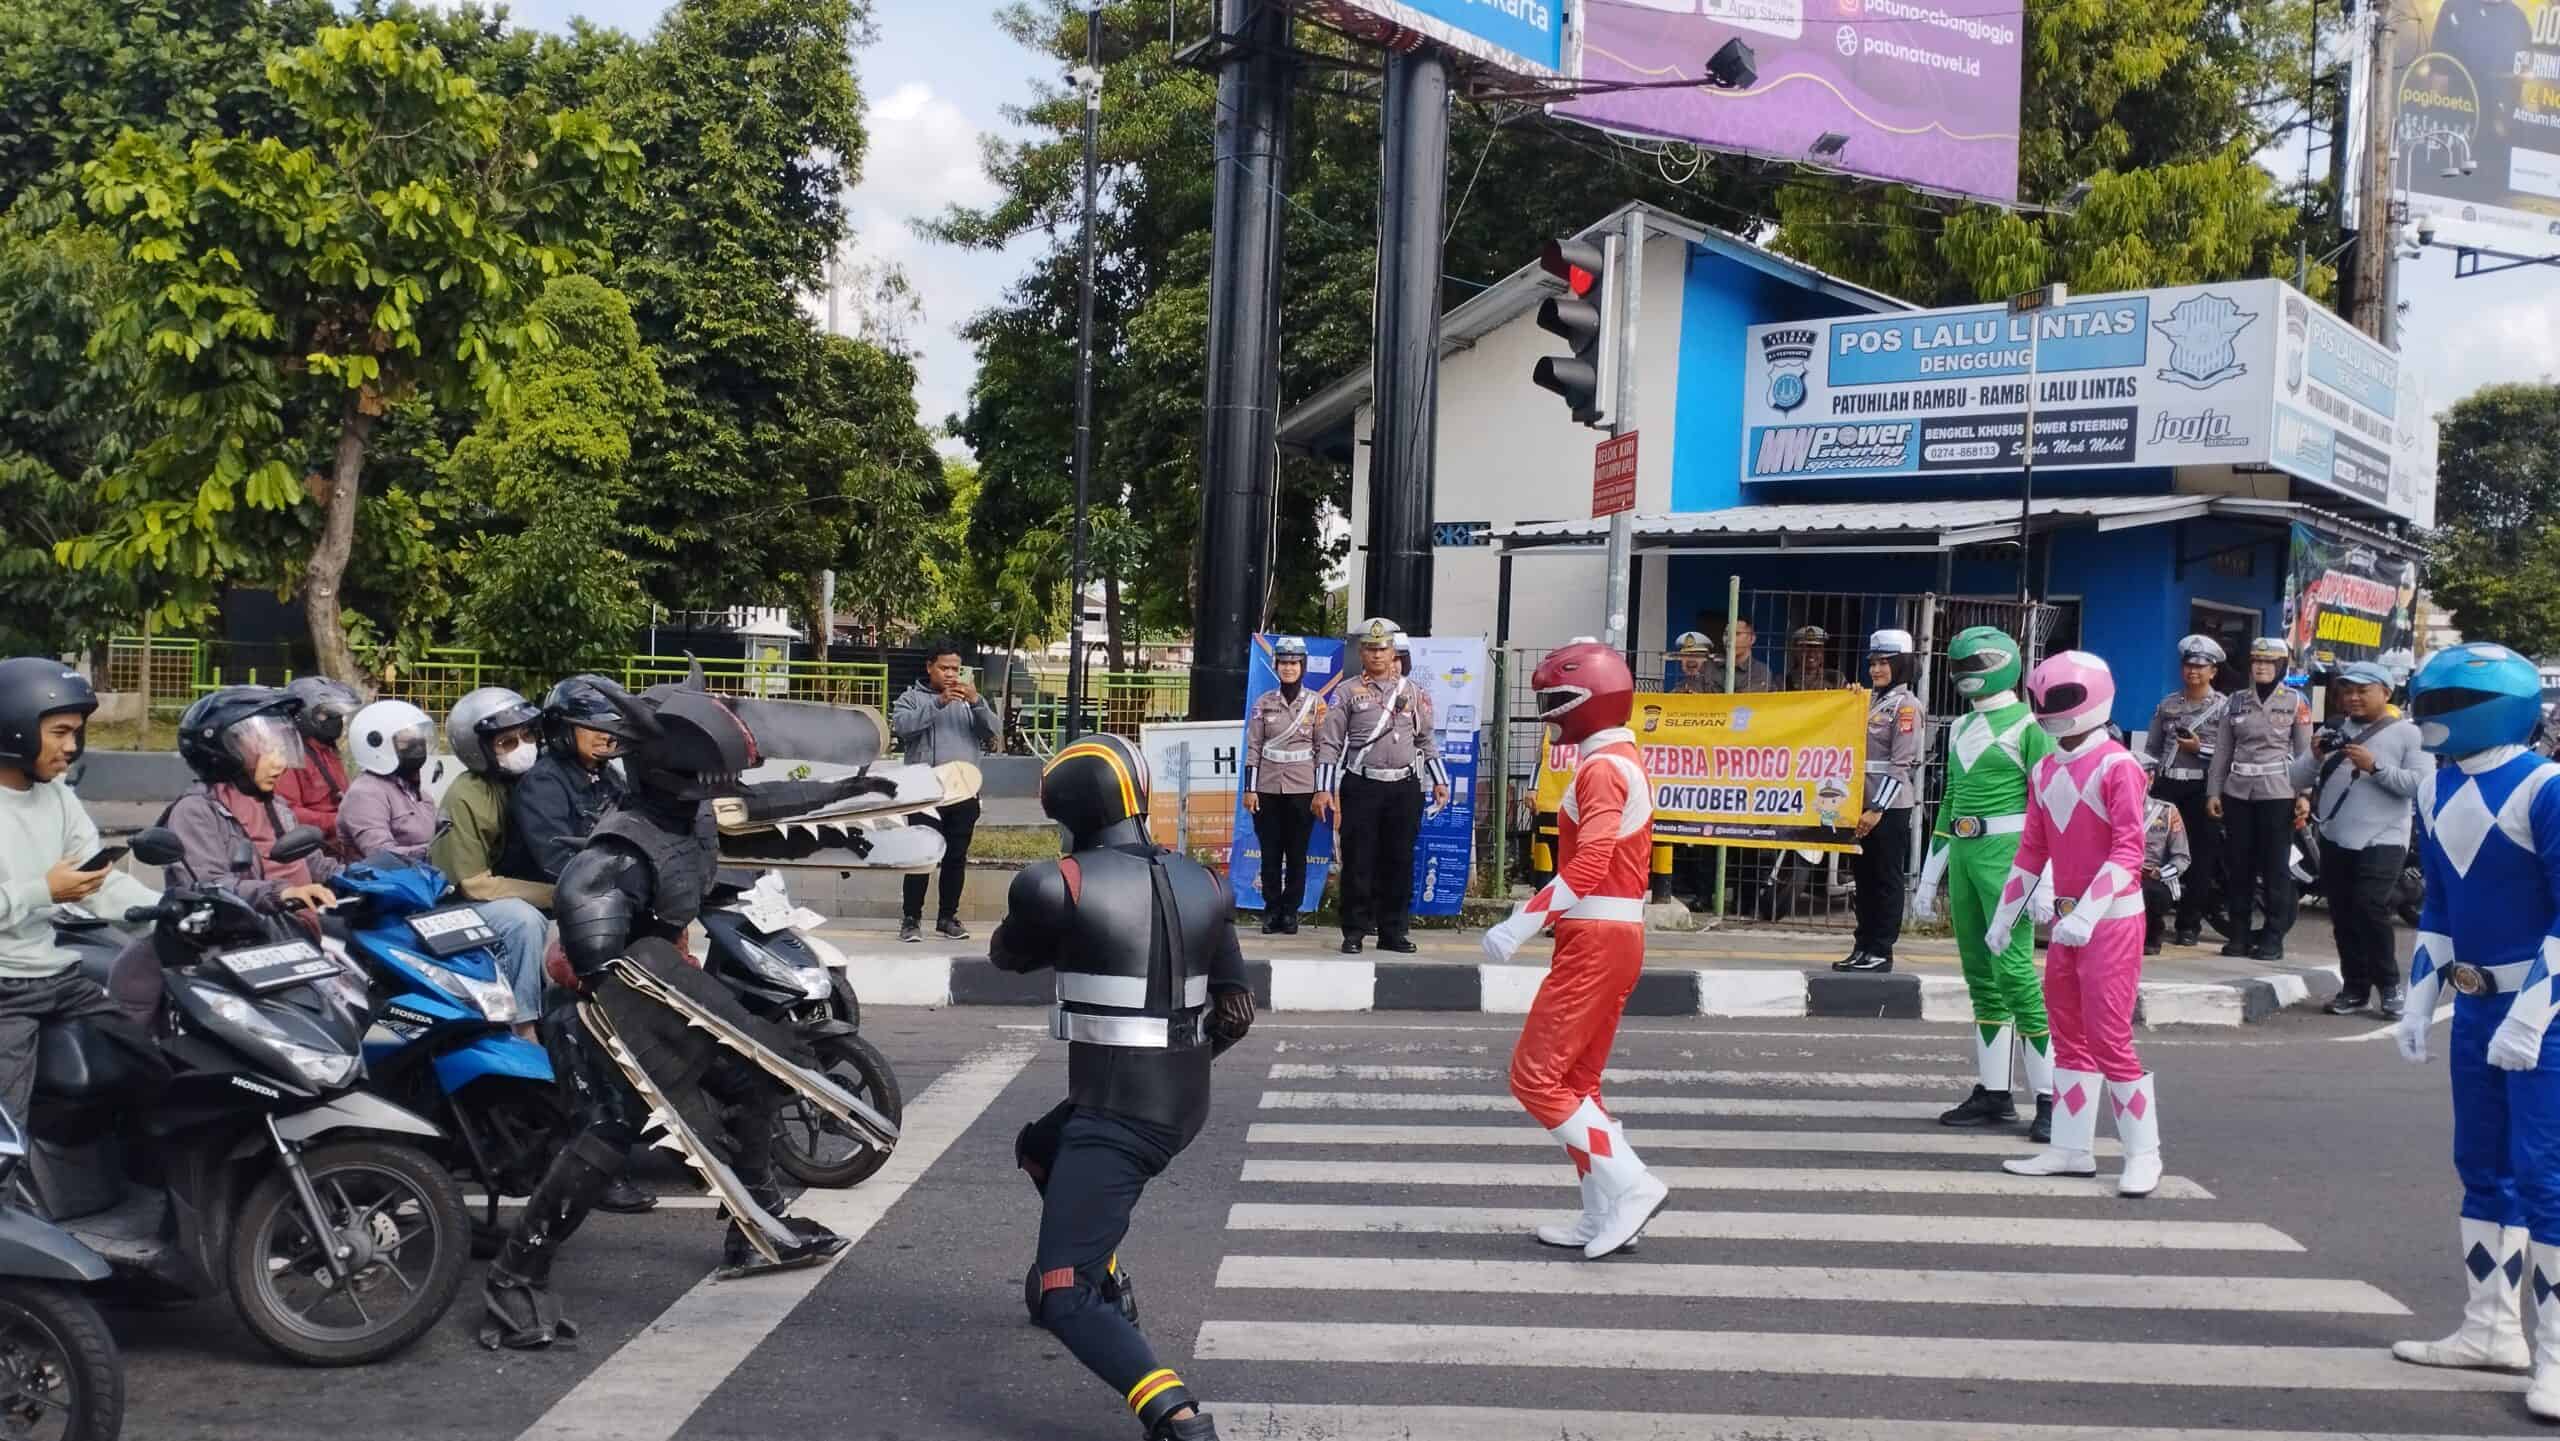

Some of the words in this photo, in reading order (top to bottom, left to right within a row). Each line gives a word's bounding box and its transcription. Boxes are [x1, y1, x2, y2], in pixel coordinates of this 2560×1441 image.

[1863, 37, 1981, 77] patunatravel.id
[1839, 328, 1902, 356] POS
[1912, 320, 1997, 350] LALU
[2009, 309, 2136, 342] LINTAS
[1919, 349, 2033, 374] DENGGUNG
[1832, 391, 1909, 415] PATUHILAH
[1912, 386, 1967, 410] RAMBU
[2040, 380, 2077, 402] LALU
[2081, 376, 2137, 400] LINTAS
[1925, 426, 1975, 440] BENGKEL
[1977, 423, 2025, 438] KHUSUS
[2031, 421, 2067, 435] OWER
[2069, 417, 2129, 433] STEERING
[1664, 718, 1726, 728] SLEMAN
[1642, 746, 1709, 777] ZEBRA
[1713, 747, 1790, 779] PROGO
[1795, 747, 1853, 781] 2024
[1657, 784, 1749, 813] OKTOBER
[1753, 788, 1805, 815] 2024
[389, 1006, 434, 1025] HONDA
[231, 1075, 280, 1099] HONDA
